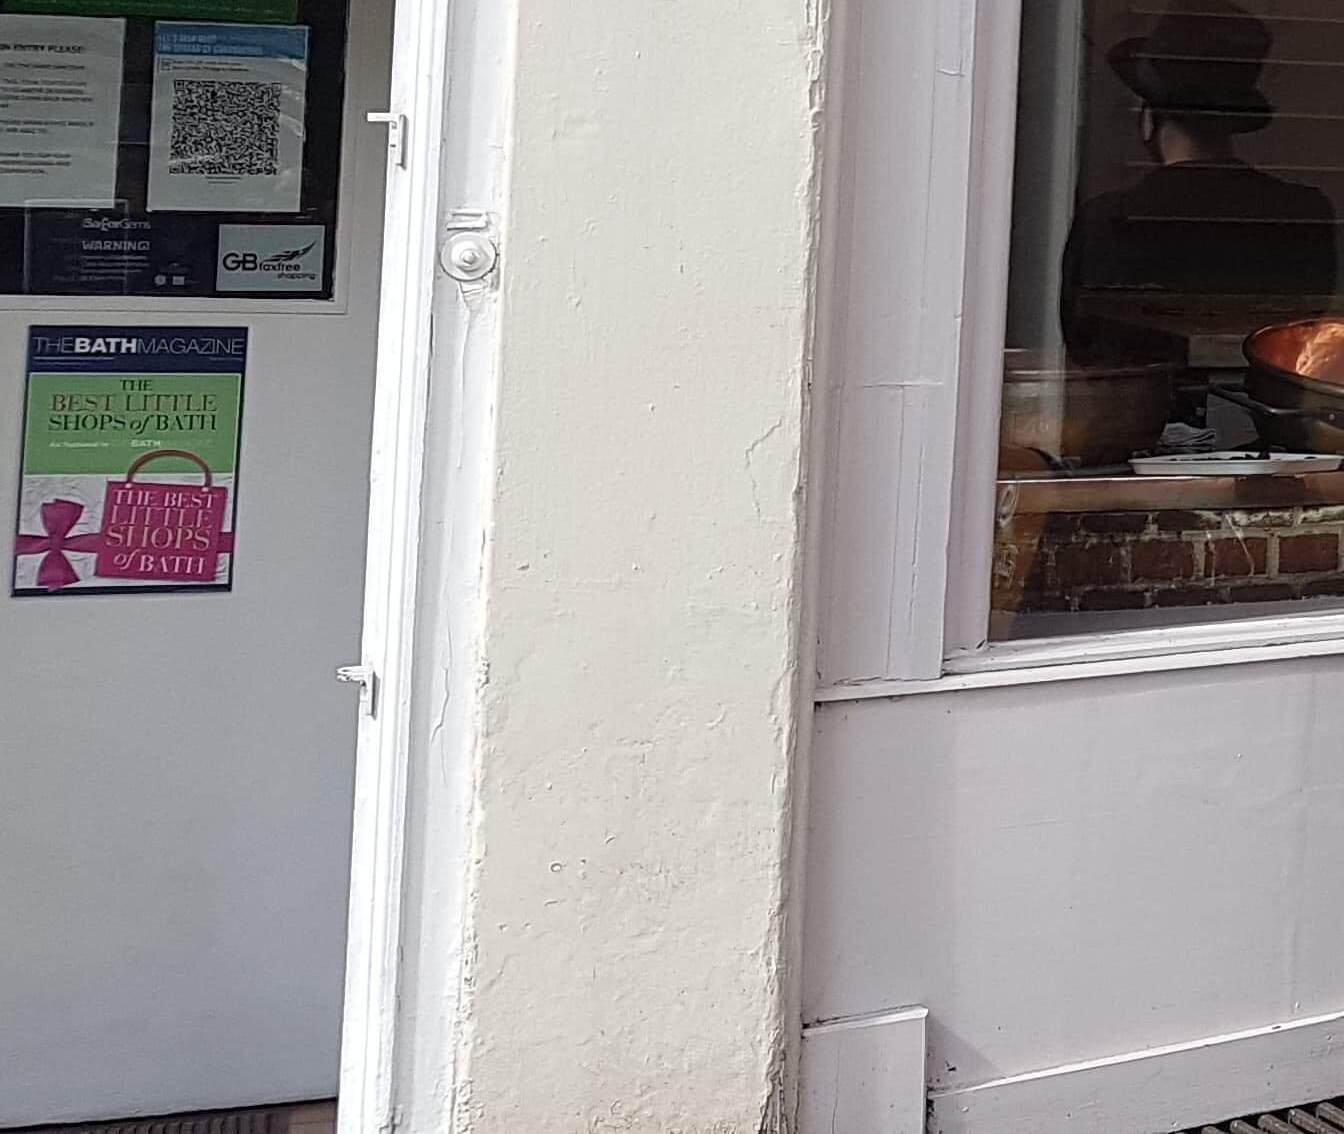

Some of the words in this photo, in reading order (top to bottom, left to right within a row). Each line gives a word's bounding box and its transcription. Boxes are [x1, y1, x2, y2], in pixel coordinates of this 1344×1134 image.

[81, 240, 150, 251] WARNING
[222, 252, 258, 272] GB
[120, 379, 153, 391] THE
[50, 394, 115, 412] BEST
[126, 394, 218, 412] LITTLE
[48, 415, 125, 431] SHOPS
[130, 415, 154, 434] of
[156, 416, 217, 431] BATH
[113, 489, 158, 507] THE
[163, 492, 218, 509] BEST
[110, 507, 214, 529] LITTLE
[106, 527, 210, 551] SHOPS
[114, 550, 136, 570] of
[139, 555, 205, 575] BATH
